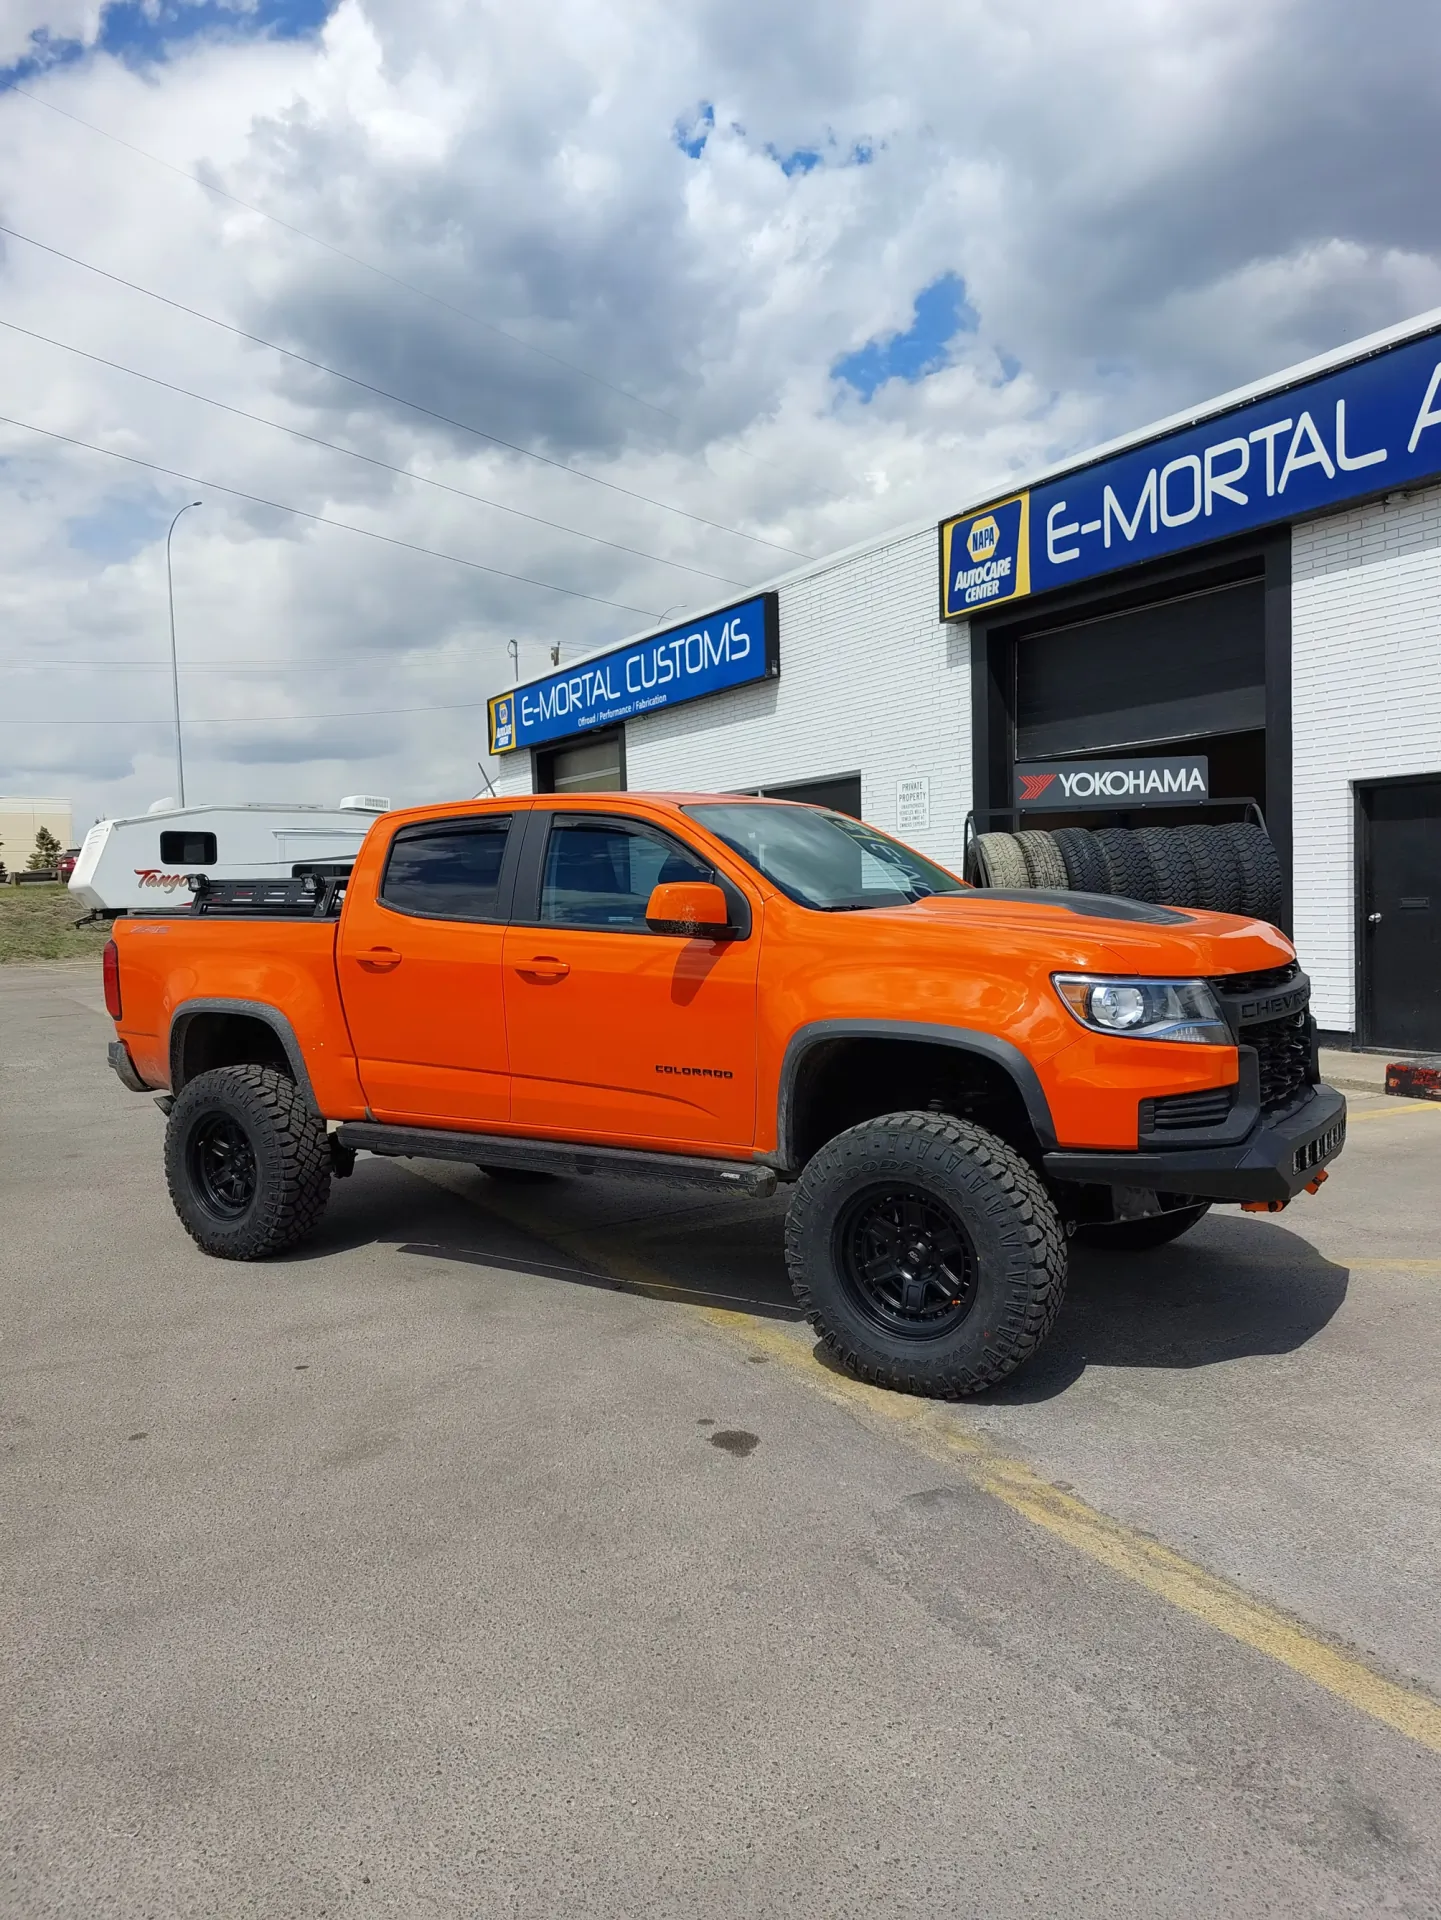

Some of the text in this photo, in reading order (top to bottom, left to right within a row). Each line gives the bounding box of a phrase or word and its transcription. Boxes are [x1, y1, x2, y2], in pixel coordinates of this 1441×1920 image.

[1046, 398, 1388, 564] E-MORTAL
[972, 526, 995, 552] NAPA
[954, 556, 1012, 592] AUTOCARE
[965, 579, 1000, 603] CENTER
[521, 618, 750, 727] E-MORTAL CUSTOMS
[577, 712, 596, 727] Offroad
[600, 705, 632, 721] Performance
[635, 694, 667, 711] Fabrication
[902, 781, 923, 792] PRIVATE
[1059, 768, 1206, 797] YOKOHAMA
[899, 792, 927, 802] PROPERTY
[134, 869, 188, 894] Tango
[655, 1065, 733, 1079] COLORADO
